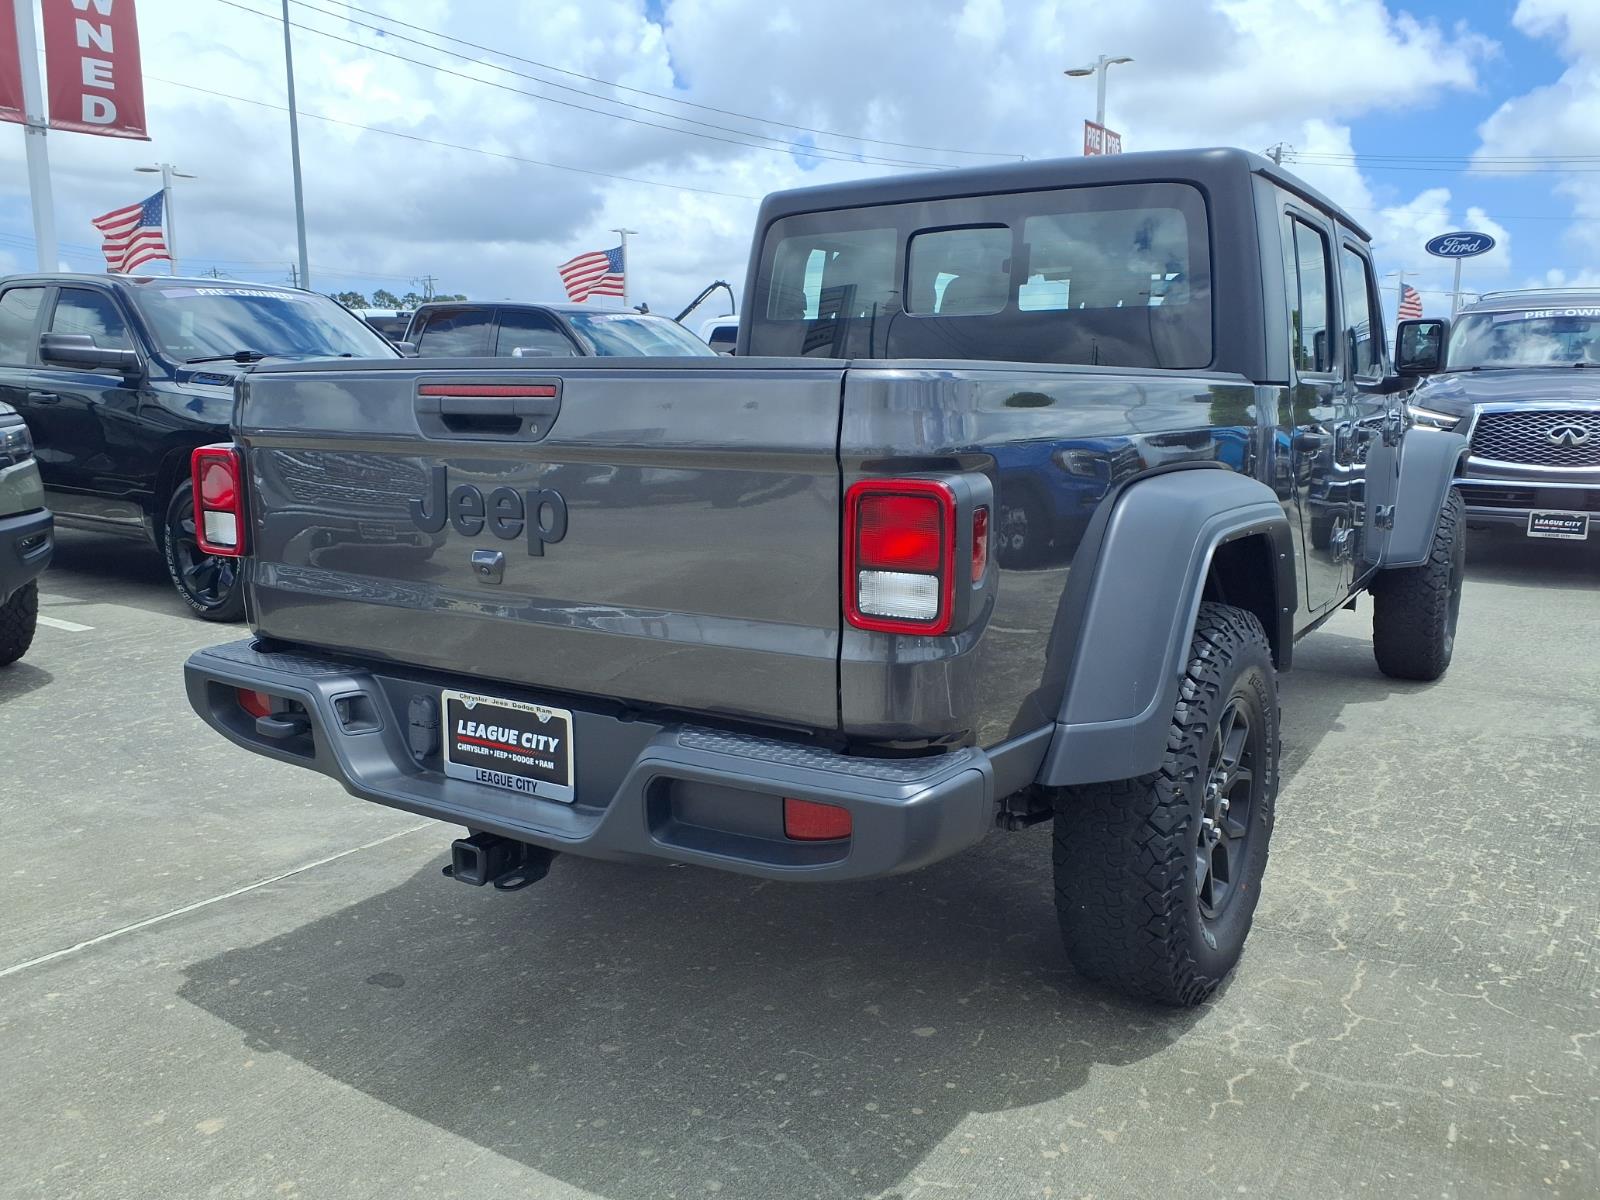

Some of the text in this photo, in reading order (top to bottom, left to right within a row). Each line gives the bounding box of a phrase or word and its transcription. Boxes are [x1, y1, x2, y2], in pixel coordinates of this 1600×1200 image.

[1439, 236, 1480, 254] Ford
[195, 288, 294, 300] PRE-OWNED
[409, 465, 568, 557] Jeep
[1535, 518, 1564, 526] LEAGUE
[459, 693, 488, 704] Chrysler
[512, 702, 535, 712] Dodge
[536, 706, 553, 715] Ram
[457, 719, 559, 753] LEAGUE CITY
[457, 742, 554, 769] CHRYSLER JEEP DODGE RAM
[476, 769, 538, 793] LEAGUE CITY
